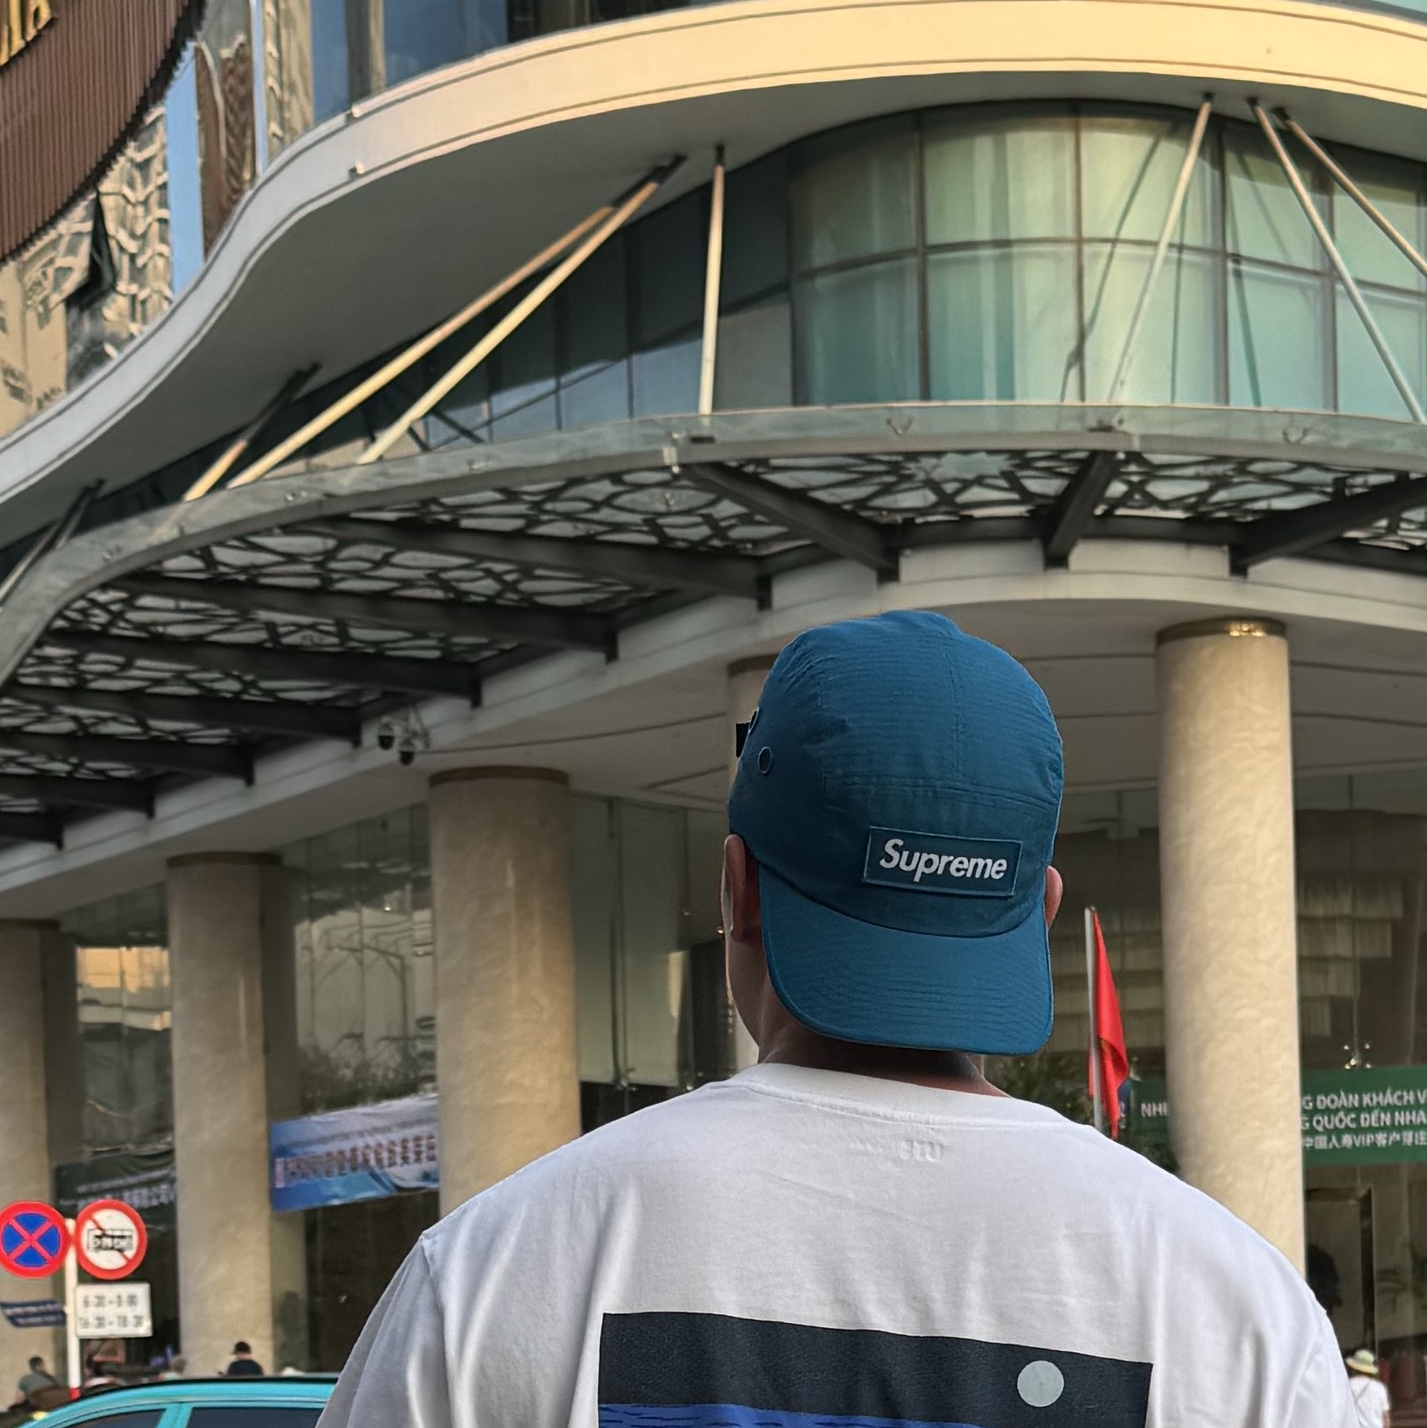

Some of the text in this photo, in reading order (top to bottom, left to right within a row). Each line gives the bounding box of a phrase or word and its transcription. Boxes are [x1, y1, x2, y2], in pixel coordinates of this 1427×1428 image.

[879, 838, 1008, 883] Supreme
[1361, 1086, 1415, 1108] KHÁCH
[1394, 1109, 1427, 1127] NHA
